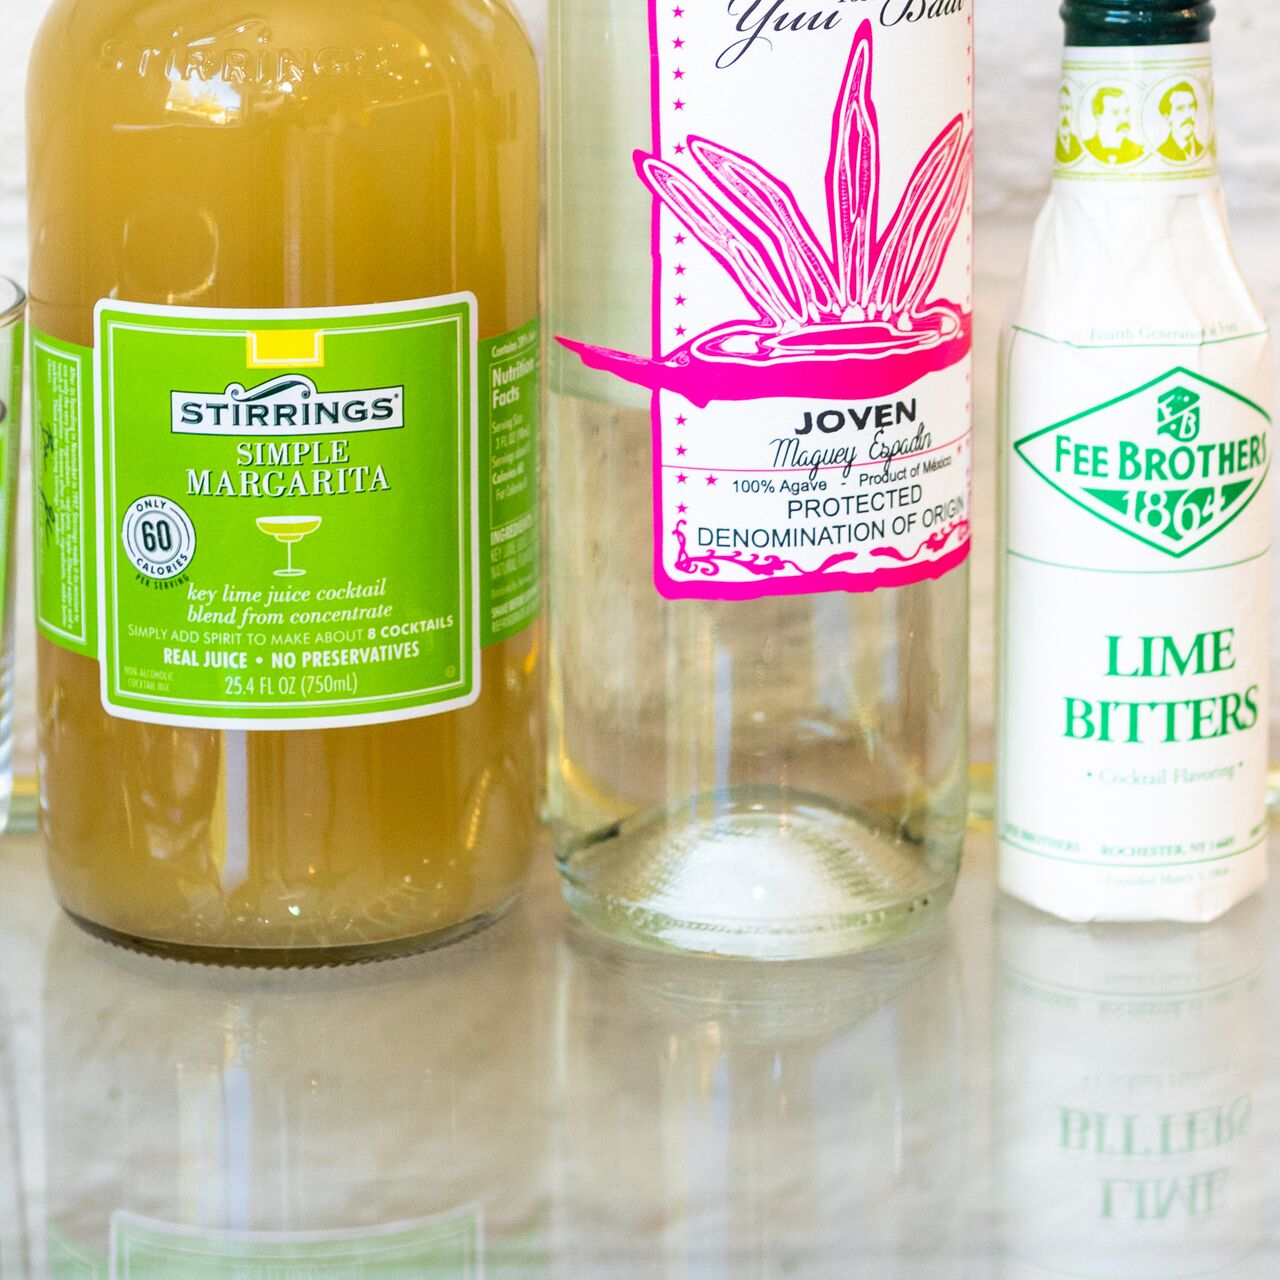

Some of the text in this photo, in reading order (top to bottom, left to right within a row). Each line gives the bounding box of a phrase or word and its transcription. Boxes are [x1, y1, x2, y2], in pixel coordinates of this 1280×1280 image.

[492, 356, 535, 388] Nutrition
[181, 396, 394, 427] STIRRINGS
[492, 385, 520, 409] Facts
[795, 397, 917, 436] JOVEN
[236, 440, 350, 467] SIMPLE
[769, 437, 857, 480] Maguey
[1055, 435, 1109, 478] FEE
[186, 464, 392, 499] MARGARITA
[733, 479, 775, 494] 100%
[780, 478, 827, 496] Agave
[859, 468, 907, 487] Product
[909, 463, 921, 478] of
[136, 499, 167, 512] ONLY
[787, 484, 922, 519] PROTECTED
[1122, 487, 1226, 537] 1864
[141, 520, 172, 552] 60
[698, 494, 966, 548] DENOMINATION OF ORIGIN
[136, 553, 188, 575] CALORIES
[136, 573, 190, 590] PER SERVING
[186, 577, 387, 608] key lime juice cocktail
[128, 614, 455, 646] SIMPLY ADD SPIRIT TO MAKE ABOUT 8 COCKTAILS
[187, 604, 393, 630] blend from concentrate
[163, 640, 420, 669] REAL JUICE NO PRESERVATIVES
[1103, 627, 1237, 677] LIME
[224, 672, 359, 698] 25.4 FL OZ (750mL)
[1061, 684, 1260, 743] BITTERS
[1098, 767, 1167, 785] Cocktail
